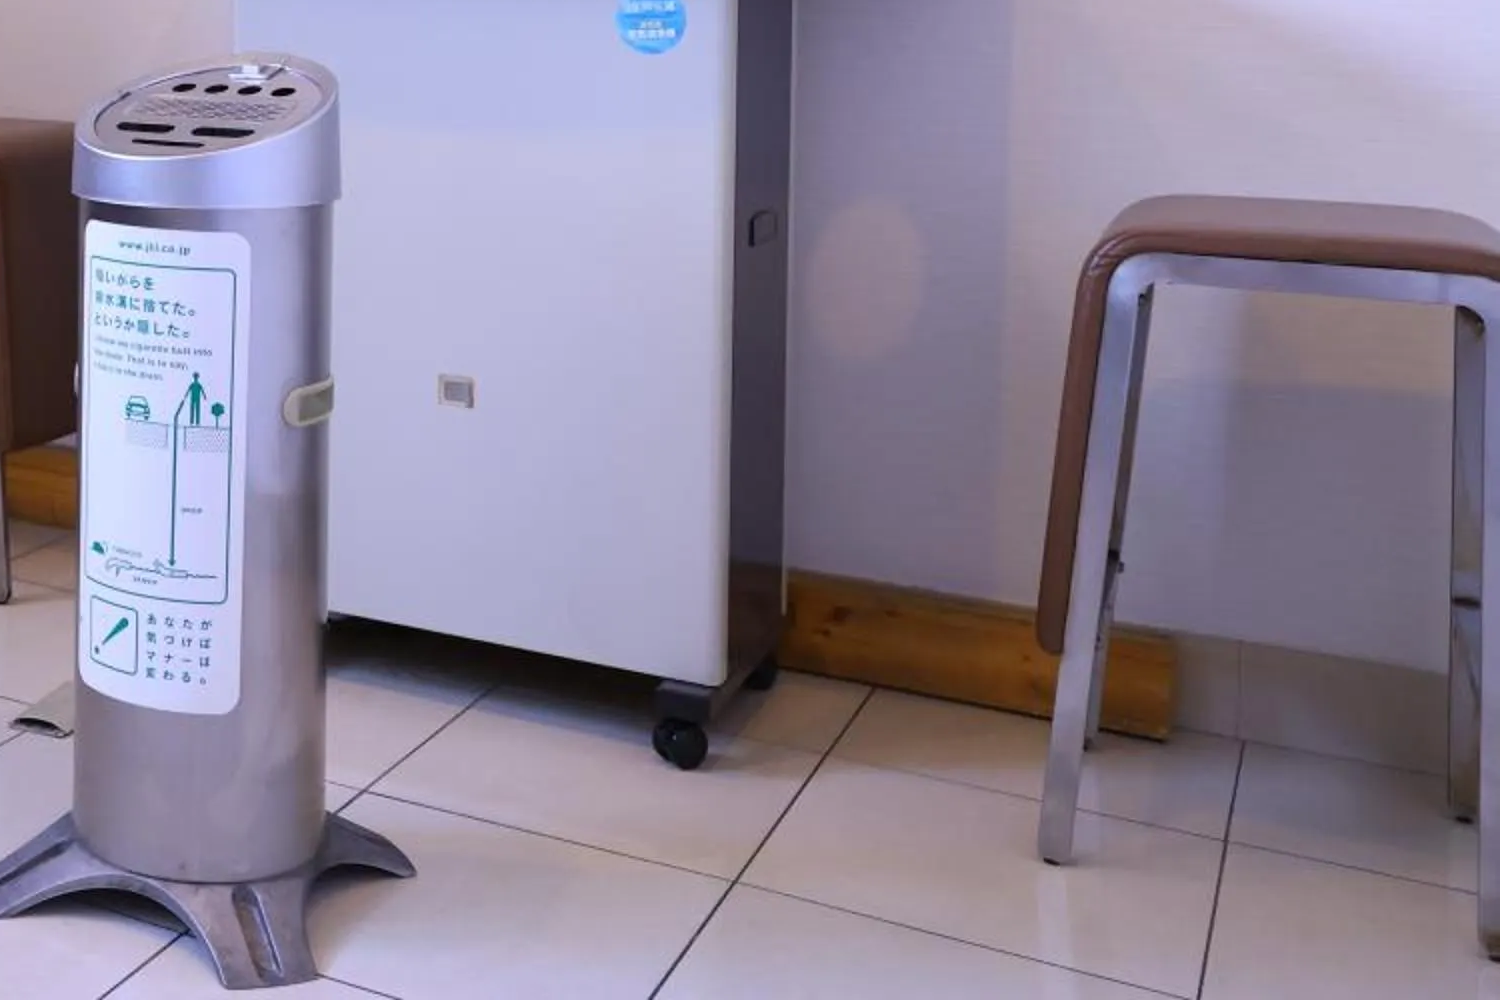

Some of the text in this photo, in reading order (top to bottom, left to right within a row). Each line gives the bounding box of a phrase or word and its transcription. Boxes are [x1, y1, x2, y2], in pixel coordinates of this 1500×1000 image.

[147, 612, 212, 630] あなたが
[147, 651, 210, 667] マナーは
